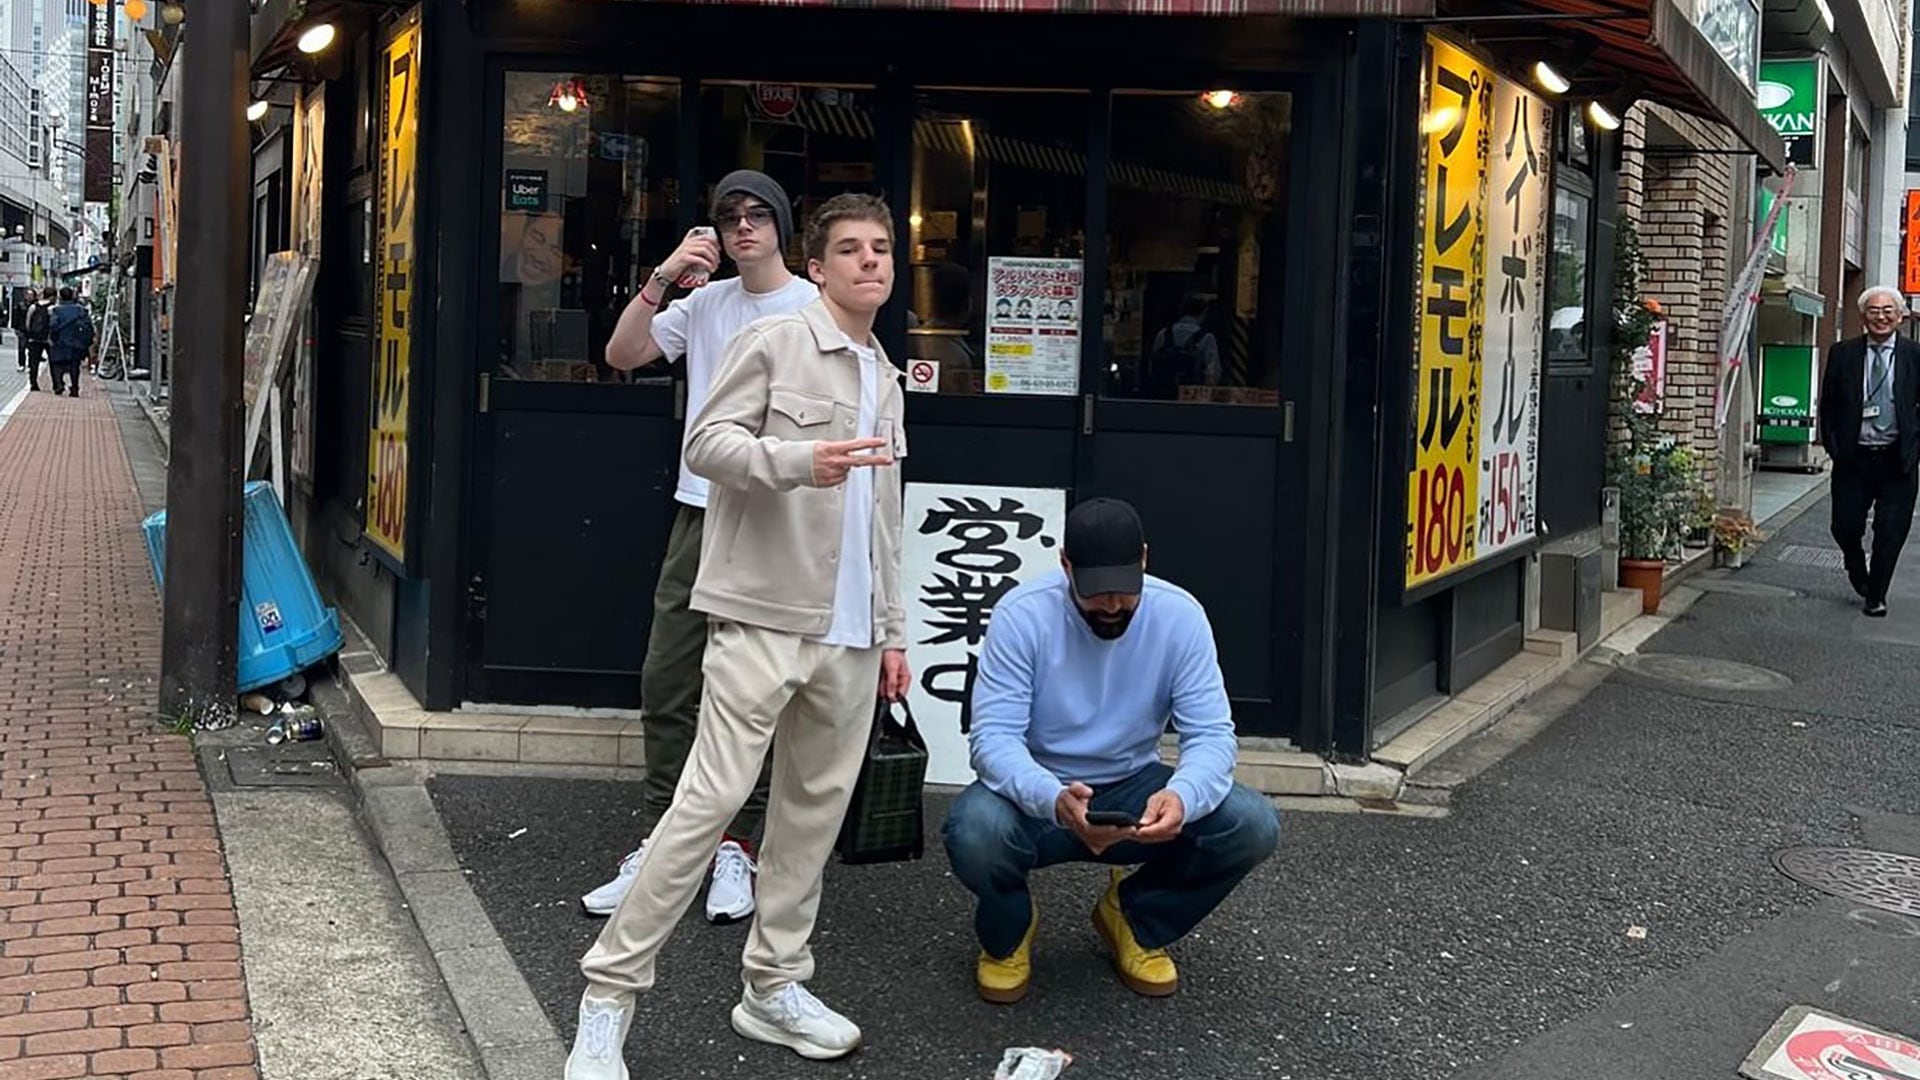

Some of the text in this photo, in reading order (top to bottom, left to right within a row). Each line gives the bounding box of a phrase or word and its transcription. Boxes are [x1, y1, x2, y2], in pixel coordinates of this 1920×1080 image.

[512, 183, 540, 195] Uber
[512, 194, 540, 206] Eats
[1419, 65, 1480, 453] プレモル
[1493, 95, 1538, 445] ハイボール
[1414, 462, 1465, 576] 180
[1489, 451, 1520, 546] 150
